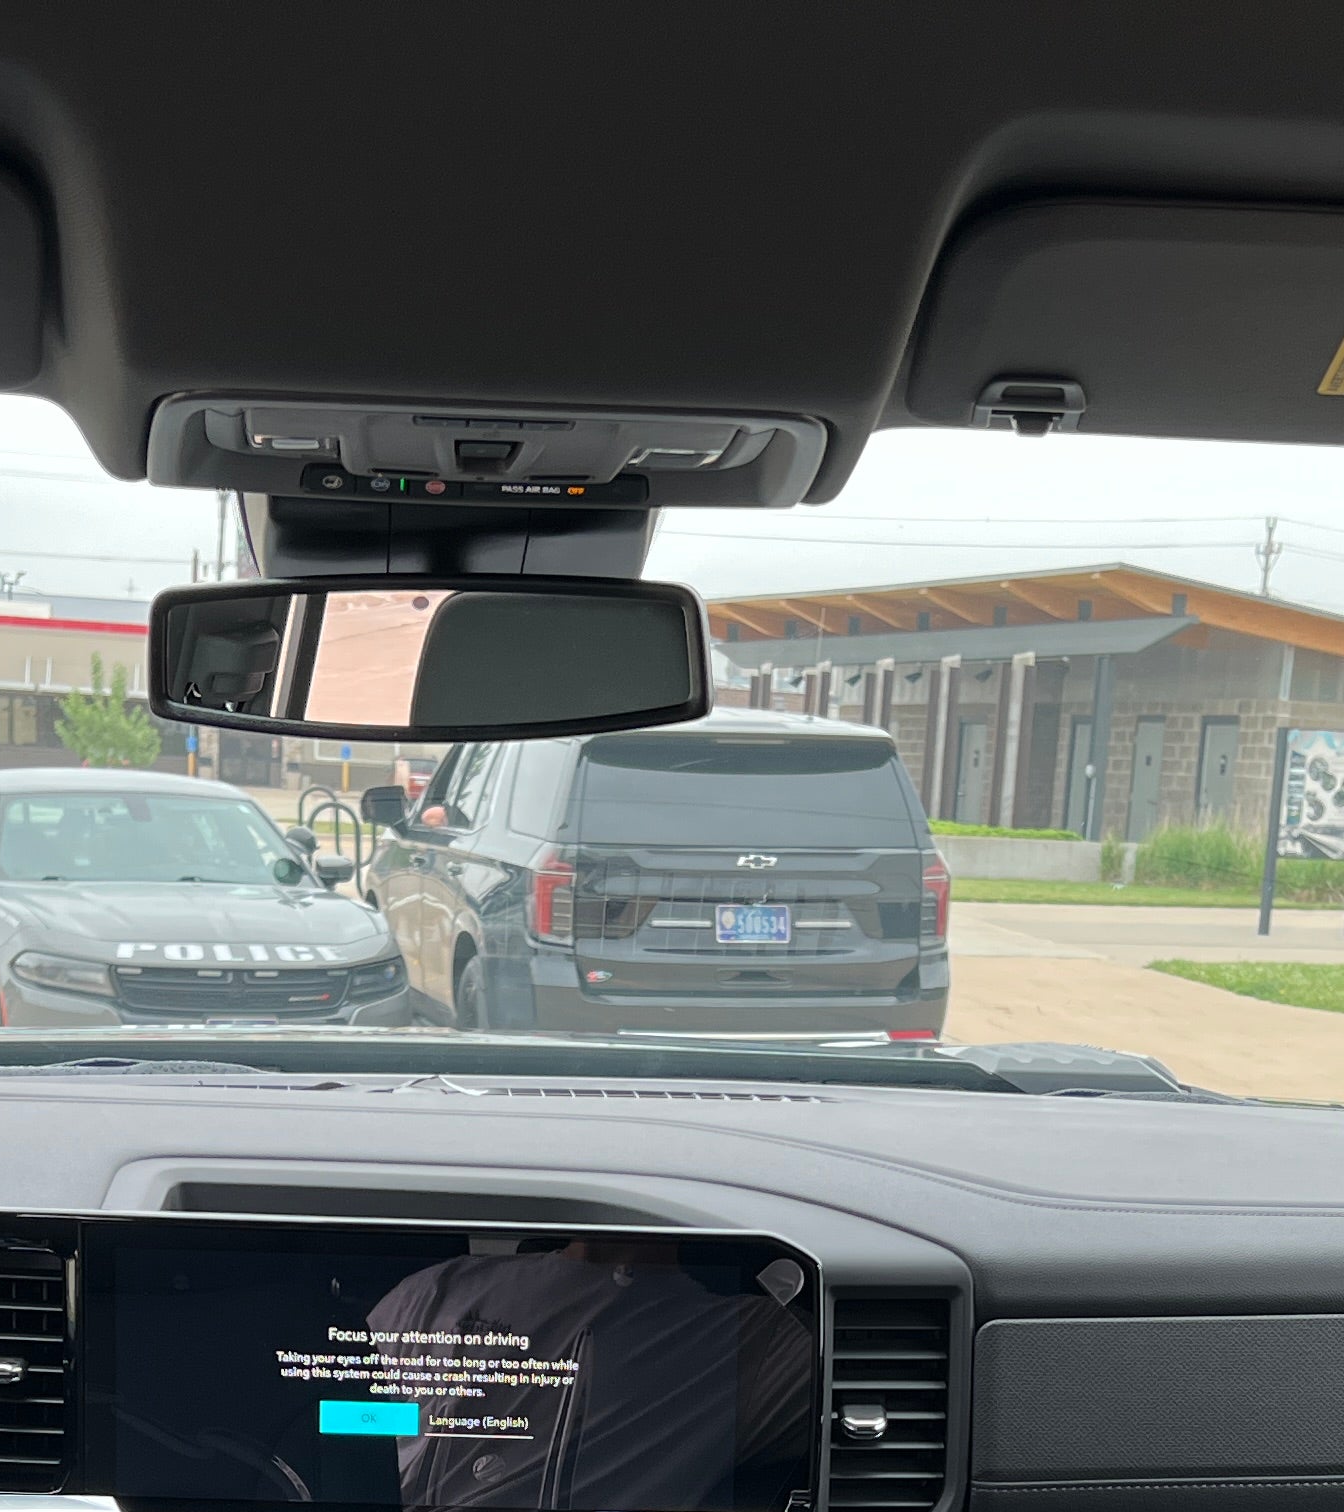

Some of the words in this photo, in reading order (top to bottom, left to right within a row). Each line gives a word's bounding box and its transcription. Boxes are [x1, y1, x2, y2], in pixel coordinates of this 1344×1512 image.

[501, 485, 523, 493] PASS
[525, 486, 541, 494] AIR
[542, 486, 560, 494] BAG
[116, 942, 348, 961] POLICE
[327, 1327, 367, 1342] Focus
[369, 1331, 399, 1346] your
[401, 1330, 461, 1345] attention
[464, 1333, 481, 1345] on
[484, 1331, 529, 1350] driving
[276, 1351, 310, 1365] Taking
[312, 1354, 336, 1366] your
[337, 1356, 361, 1367] eyes
[363, 1354, 379, 1365] off
[381, 1354, 398, 1366] the
[400, 1355, 424, 1366] road
[425, 1356, 441, 1367] for
[443, 1357, 460, 1367] too
[463, 1357, 486, 1370] long
[488, 1360, 500, 1368] or
[501, 1358, 519, 1368] too
[521, 1358, 549, 1369] often
[551, 1359, 579, 1371] while
[281, 1368, 310, 1380] using
[312, 1367, 331, 1378] this
[333, 1369, 370, 1381] system
[372, 1369, 400, 1380] could
[402, 1371, 432, 1381] cause
[434, 1373, 441, 1381] a
[442, 1371, 470, 1382] crash
[473, 1372, 517, 1386] resulting
[520, 1374, 530, 1383] in
[532, 1374, 561, 1388] injury
[563, 1377, 575, 1385] or
[369, 1383, 400, 1394] death
[402, 1385, 413, 1395] to
[415, 1388, 434, 1398] you
[435, 1388, 447, 1396] or
[448, 1387, 486, 1398] others.
[361, 1413, 377, 1424] OK
[429, 1415, 481, 1429] Language
[482, 1416, 529, 1431] (English)
